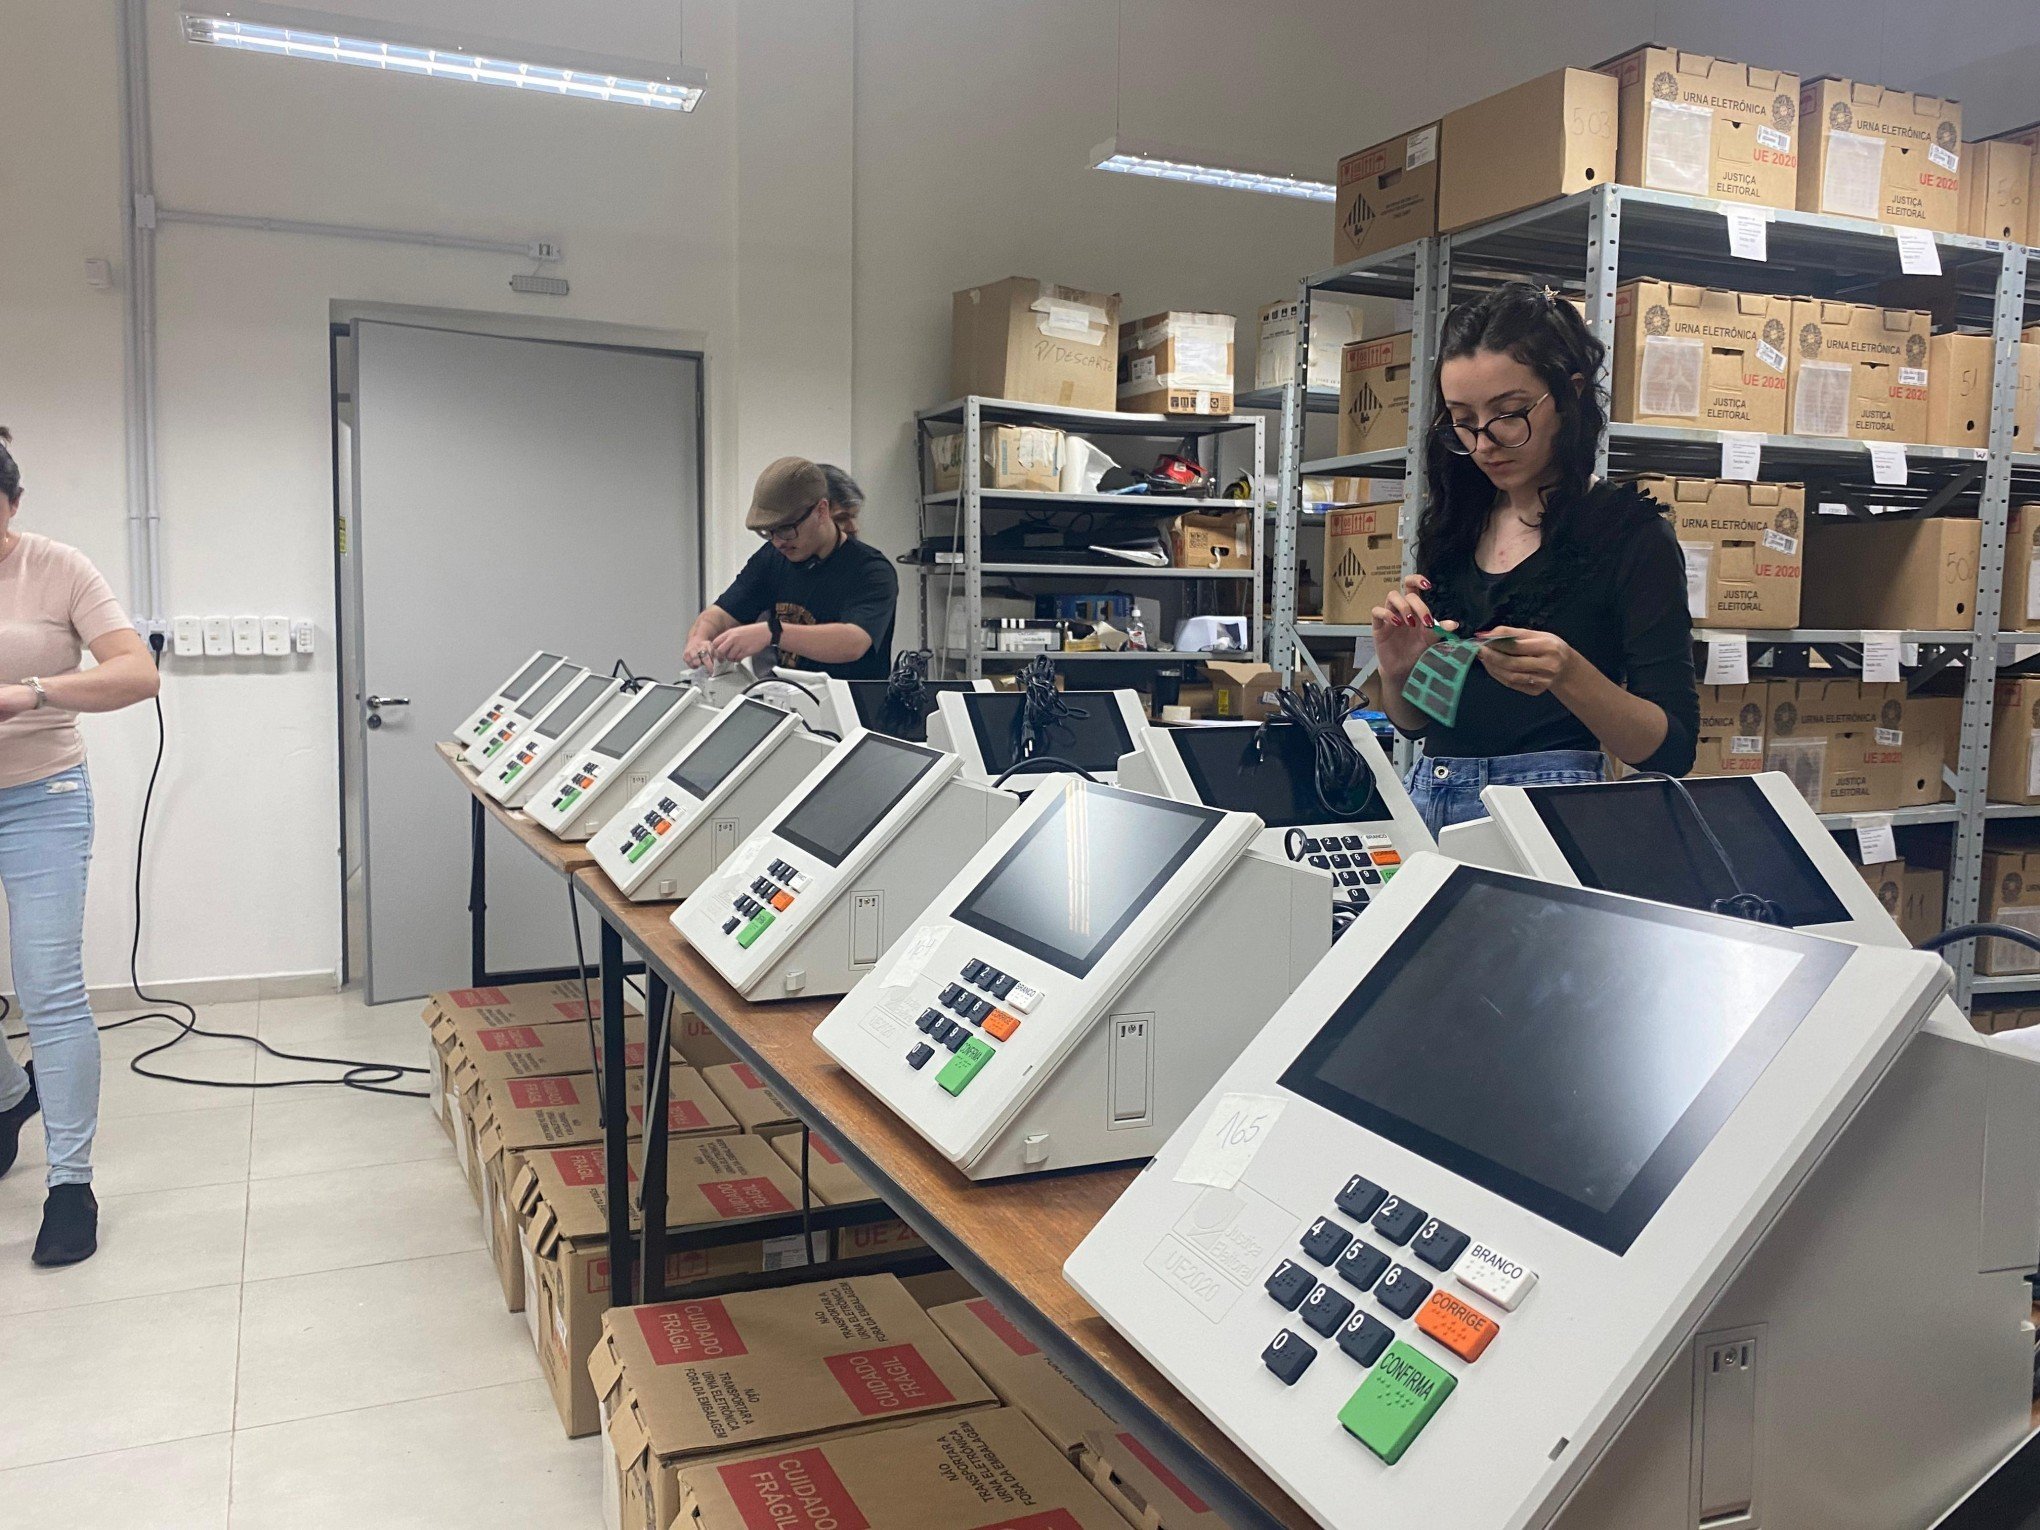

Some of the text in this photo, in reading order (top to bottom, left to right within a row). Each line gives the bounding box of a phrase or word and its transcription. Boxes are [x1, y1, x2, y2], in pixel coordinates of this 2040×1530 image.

[1683, 91, 1767, 116] URNA ELETRÔNICA
[1856, 119, 1932, 142] URNA ELETRÔNICA
[1753, 148, 1797, 168] UE 2020
[1722, 171, 1757, 185] JUSTIÇA
[1919, 172, 1958, 191] UE 2020
[1716, 182, 1760, 198] ELEITORAL
[1892, 194, 1923, 208] JUSTIÇA
[1886, 206, 1926, 220] ELEITORAL
[1675, 322, 1757, 341] URNA ELETRÔNICA
[1826, 339, 1901, 356] URNA ELETRÔNICA
[1743, 374, 1786, 390] UE 2020
[1713, 397, 1746, 409] JUSTIÇA
[1889, 386, 1927, 401] UE 2020
[1707, 408, 1751, 421] ELEITORAL
[1860, 409, 1892, 420] JUSTIÇA
[1855, 420, 1896, 432] ELEITORAL
[1682, 518, 1768, 531] URNA ELETRÔNICA
[1755, 564, 1800, 578] UE 2020
[1723, 590, 1758, 600] JUSTIÇA
[1717, 601, 1763, 612] ELEITORAL
[1721, 758, 1736, 770] UE
[1864, 752, 1878, 764] UE
[1835, 777, 1866, 786] JUSTIÇA
[1830, 787, 1870, 798] ELEITORAL
[979, 967, 990, 977] 2
[996, 975, 1005, 985] 3
[957, 992, 968, 1002] 5
[972, 1001, 983, 1011] 6
[935, 1017, 945, 1027] 8
[949, 1027, 959, 1037] 9
[1216, 1110, 1268, 1149] 165
[1346, 1177, 1439, 1239] 1 2 3
[1311, 1220, 1402, 1286] 4 5 6
[1471, 1244, 1523, 1280] BRANCO
[1274, 1261, 1365, 1332] 7 8 9
[1431, 1292, 1487, 1332] CORRIGE
[659, 1313, 692, 1354] FRÁGIL
[684, 1305, 723, 1355] CUIDADO
[853, 1323, 872, 1340] URNA
[1272, 1332, 1289, 1350] 0
[849, 1356, 900, 1407] CUIDADO
[881, 1355, 926, 1398] FRÁGIL
[1379, 1352, 1436, 1402] CONFIRMA
[684, 1367, 728, 1439] FORA DA EMBALAGEM
[702, 1371, 741, 1432] URNA ELETRÔNICA
[718, 1371, 753, 1419] TRANSPORTAR
[744, 1388, 760, 1403] NÃO
[938, 1463, 960, 1482] NÃO
[941, 1443, 995, 1503] TRANSPORTAR
[948, 1429, 1014, 1504] URNA ELETRÔNICA
[958, 1420, 1037, 1507] FORA DA EMBALAGEM
[778, 1458, 838, 1530] CUIDADO
